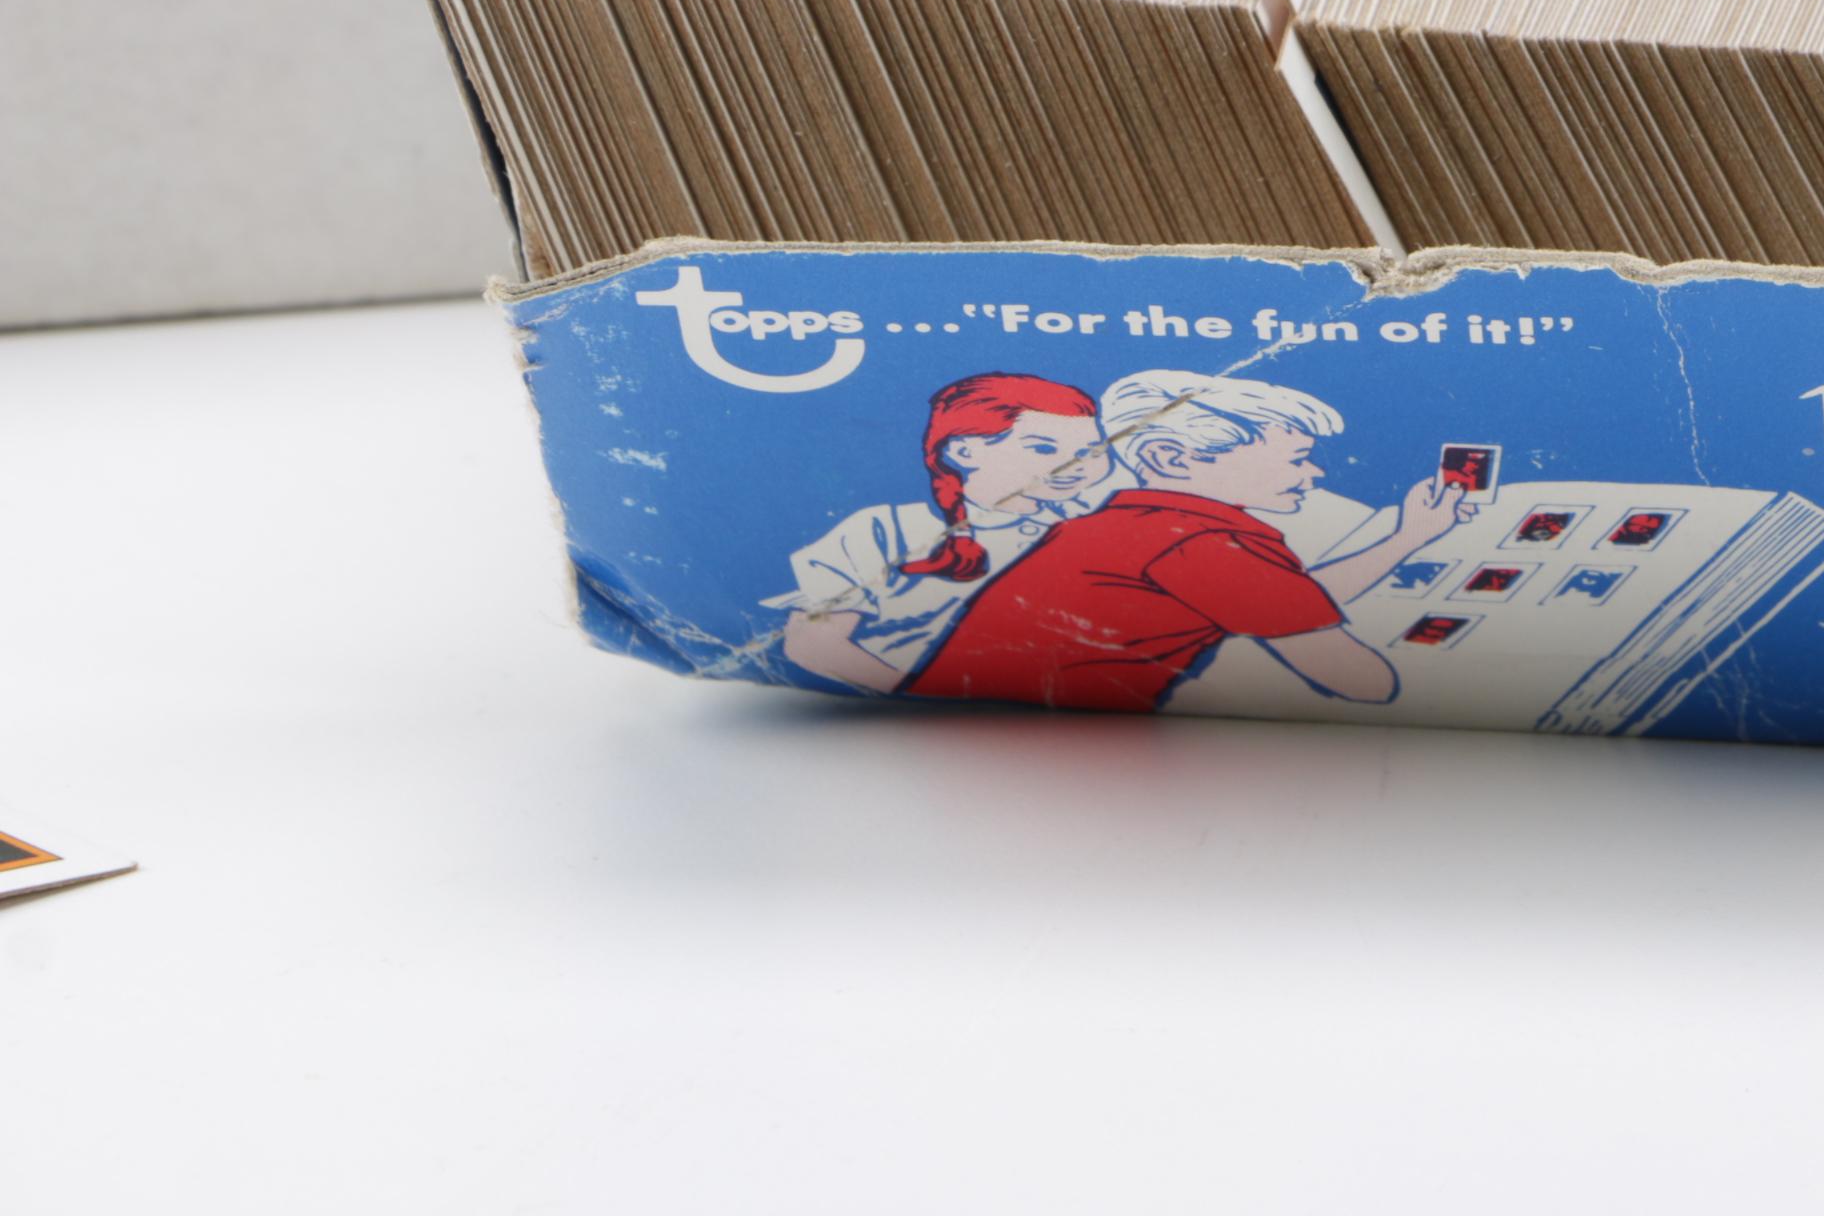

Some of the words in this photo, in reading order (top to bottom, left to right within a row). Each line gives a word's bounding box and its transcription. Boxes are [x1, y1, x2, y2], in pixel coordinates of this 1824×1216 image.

[1122, 304, 1233, 340] the
[1251, 308, 1360, 344] fun
[1379, 311, 1449, 344] of
